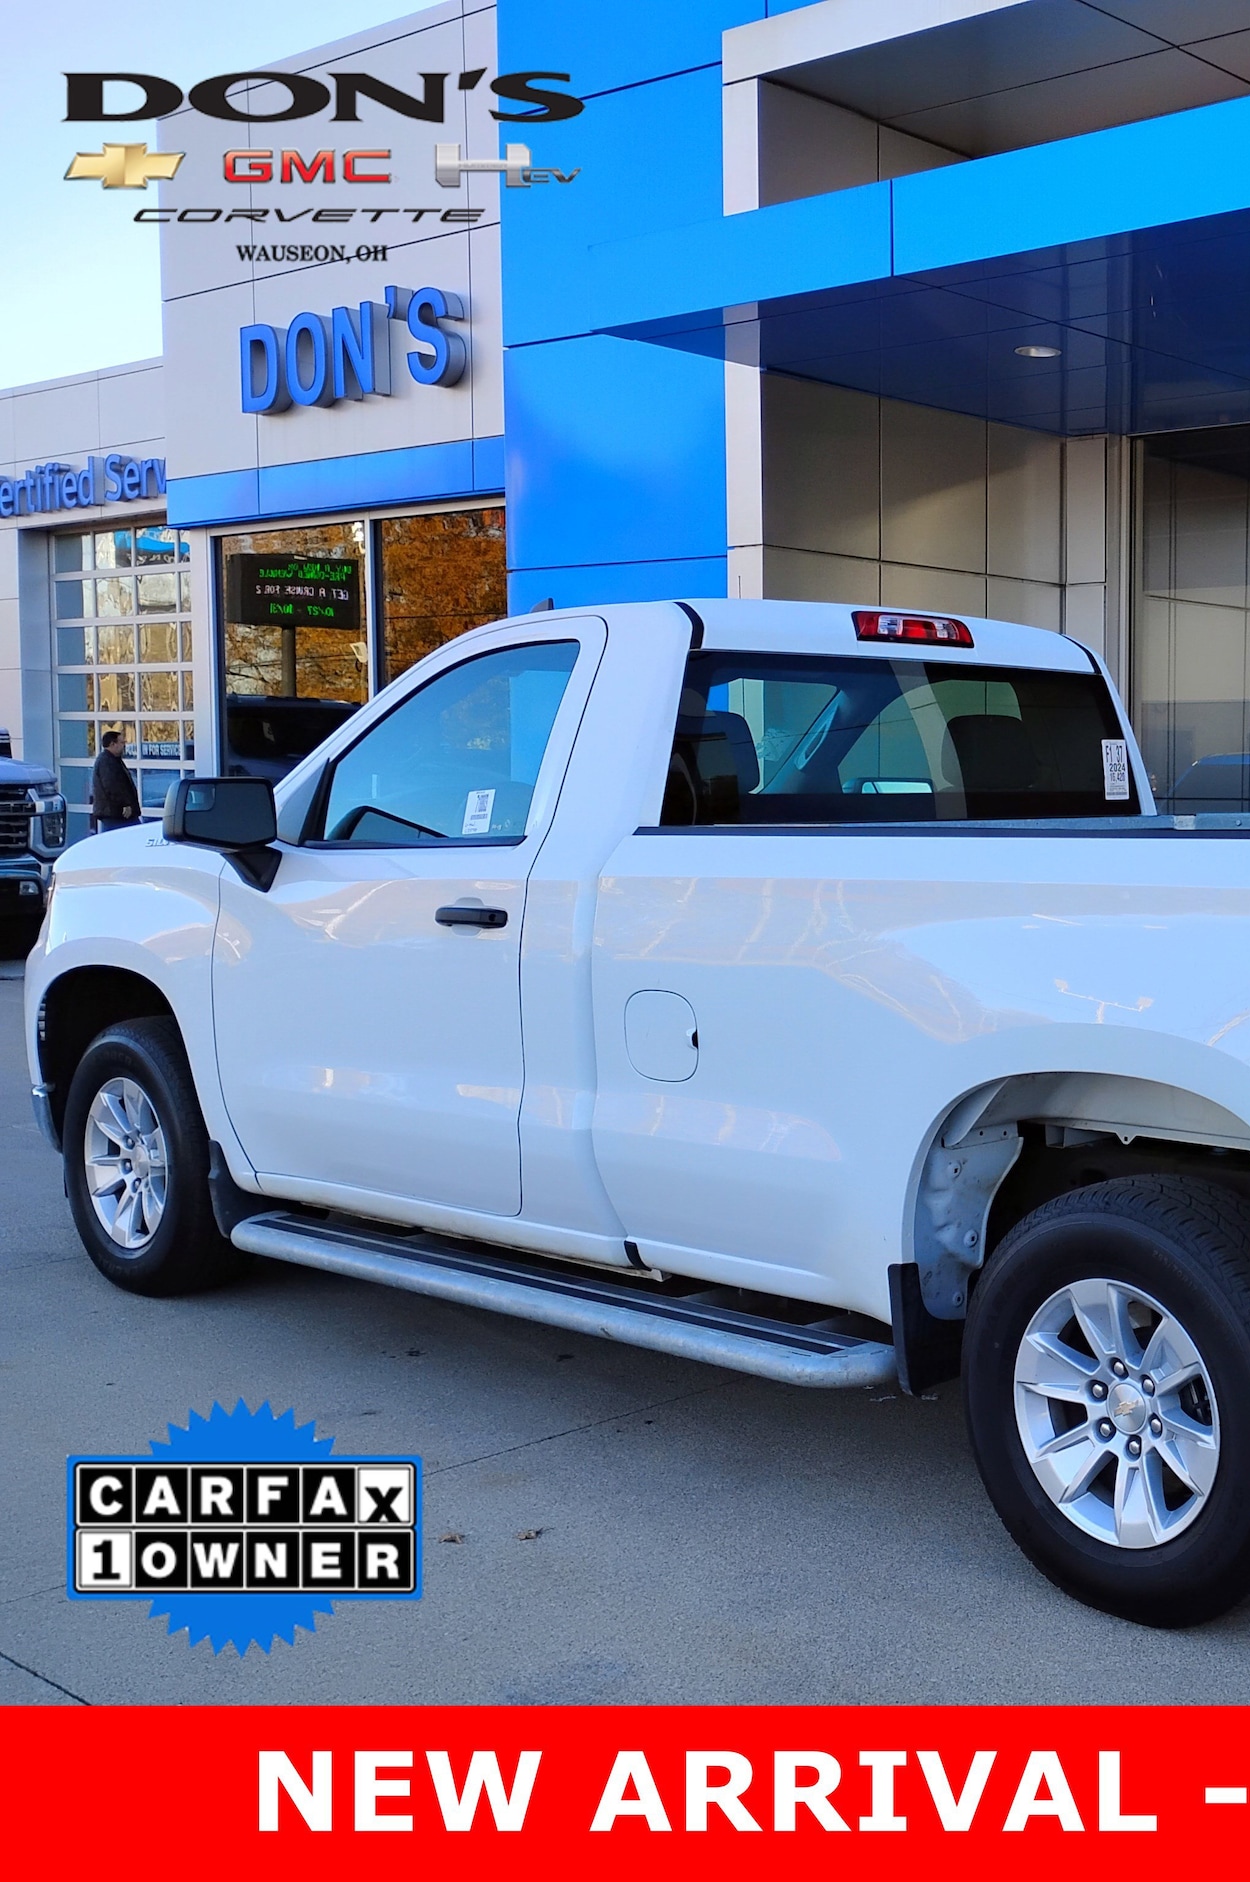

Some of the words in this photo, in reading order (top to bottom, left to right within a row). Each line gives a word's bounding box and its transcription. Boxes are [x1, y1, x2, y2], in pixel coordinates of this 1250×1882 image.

[240, 285, 465, 414] DON'S
[0, 456, 104, 518] ertified
[105, 453, 166, 501] Serv
[1109, 763, 1126, 772] 2024
